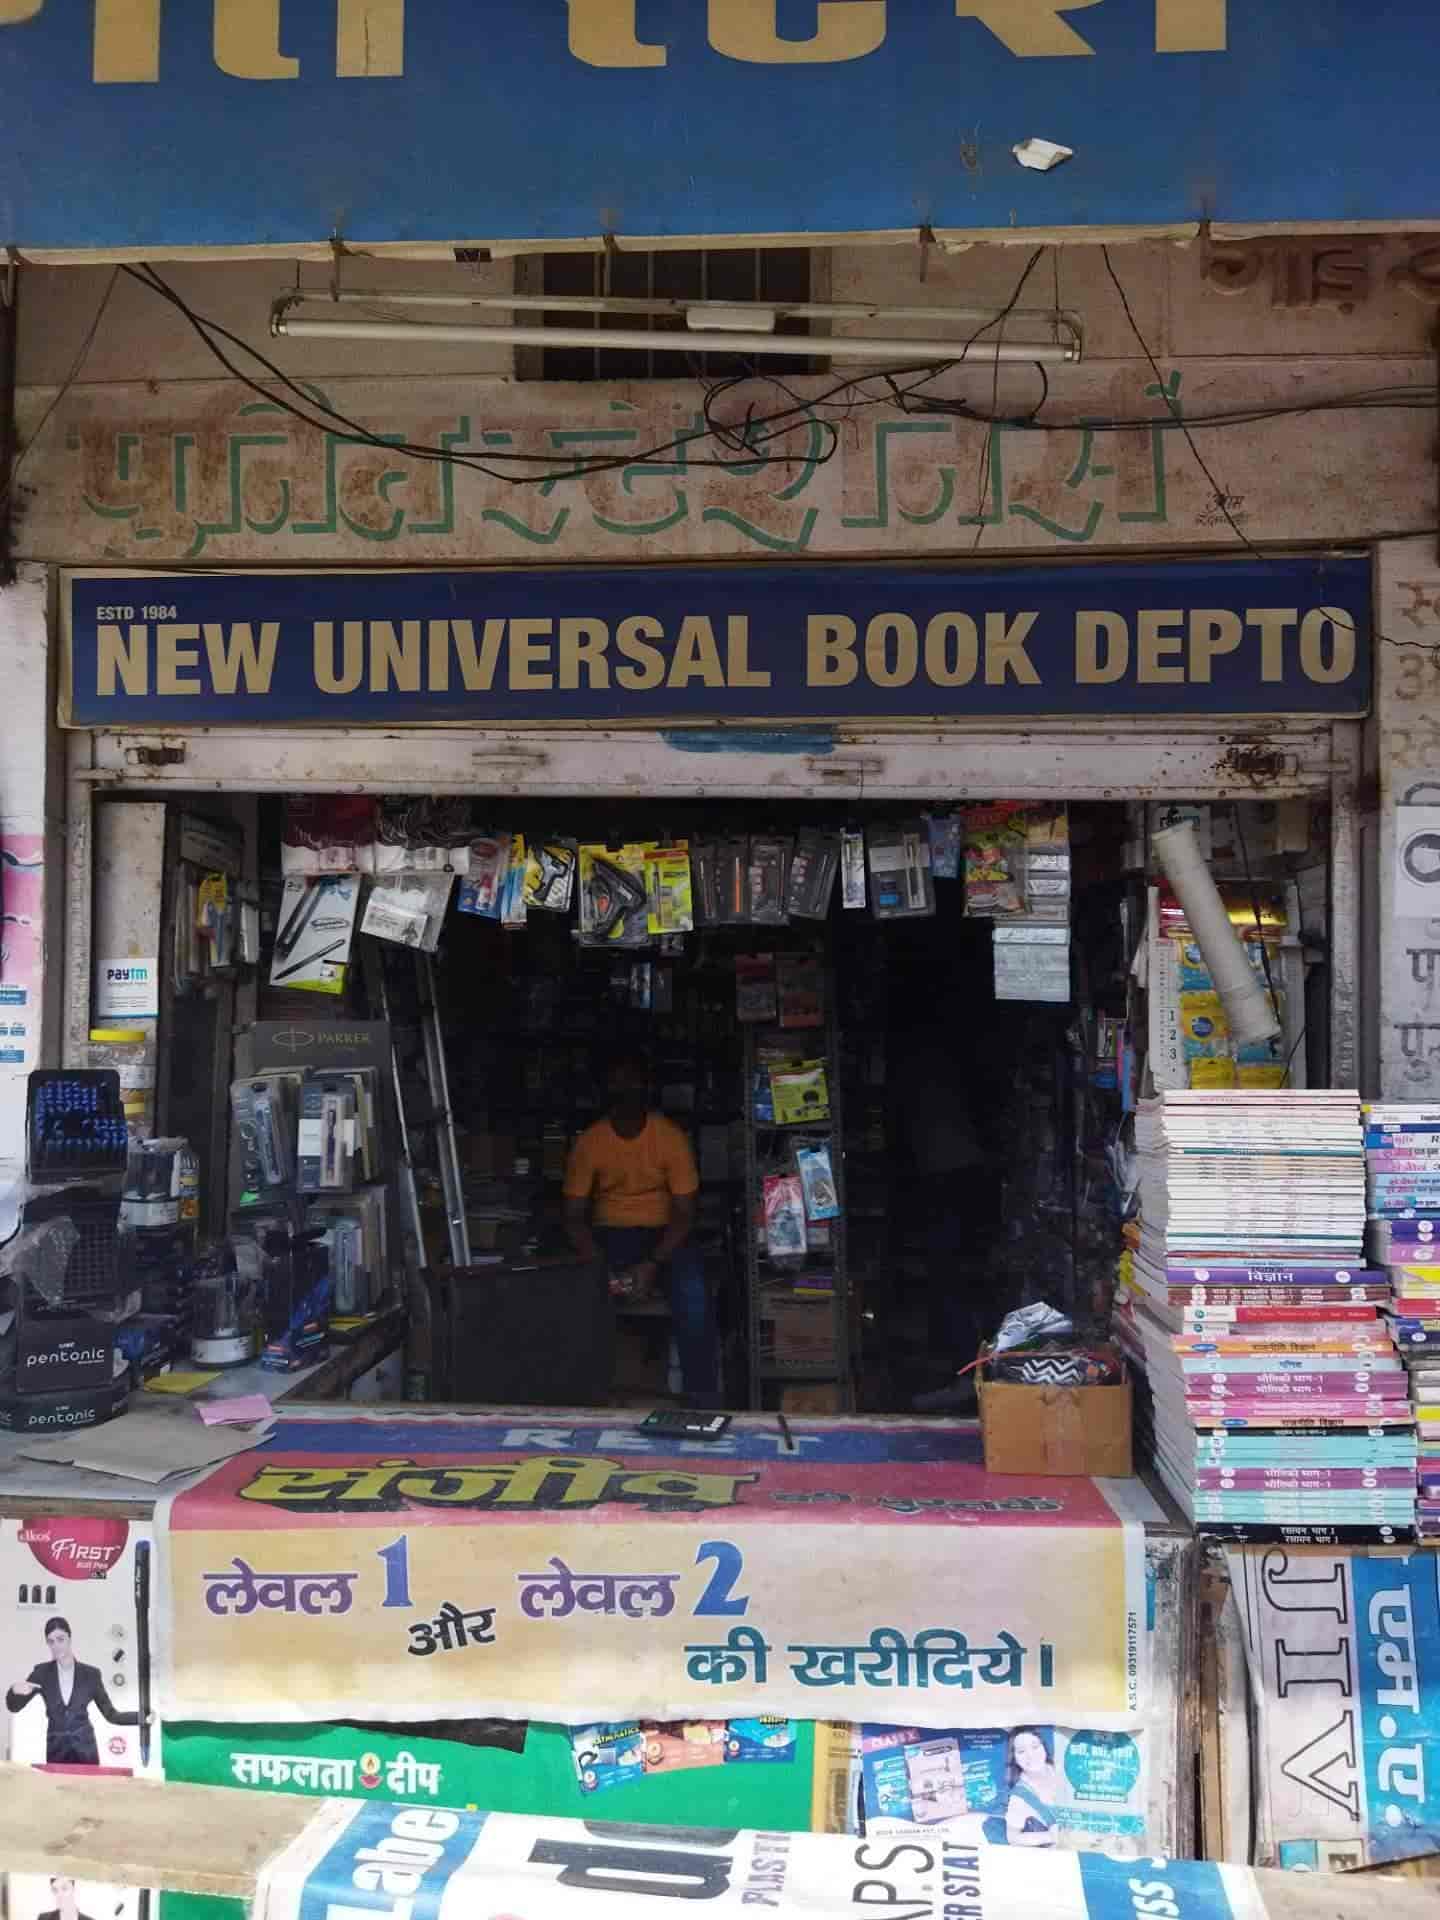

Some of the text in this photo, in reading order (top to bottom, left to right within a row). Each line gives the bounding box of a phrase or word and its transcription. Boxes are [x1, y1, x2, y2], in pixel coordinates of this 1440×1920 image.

[96, 604, 178, 620] ESTD 1984
[96, 622, 280, 697] NEW
[313, 614, 772, 694] UNIVERSAL
[806, 610, 1042, 688] BOOK
[1074, 605, 1358, 686] DEPTO
[107, 968, 148, 981] paytm
[317, 1031, 369, 1044] PARKER
[1247, 1269, 1293, 1283] विज्ञान
[26, 1346, 105, 1367] pentonic
[28, 1408, 96, 1425] pentonic
[239, 1455, 760, 1513] संजीव
[202, 1557, 359, 1616] लेवल
[377, 1534, 414, 1608] 1
[407, 1602, 497, 1658] और
[517, 1556, 681, 1618] लेवल
[694, 1540, 751, 1617] 2
[683, 1626, 773, 1685] की
[230, 1752, 442, 1796] सफलता दीप
[942, 1841, 981, 1898] STAT
